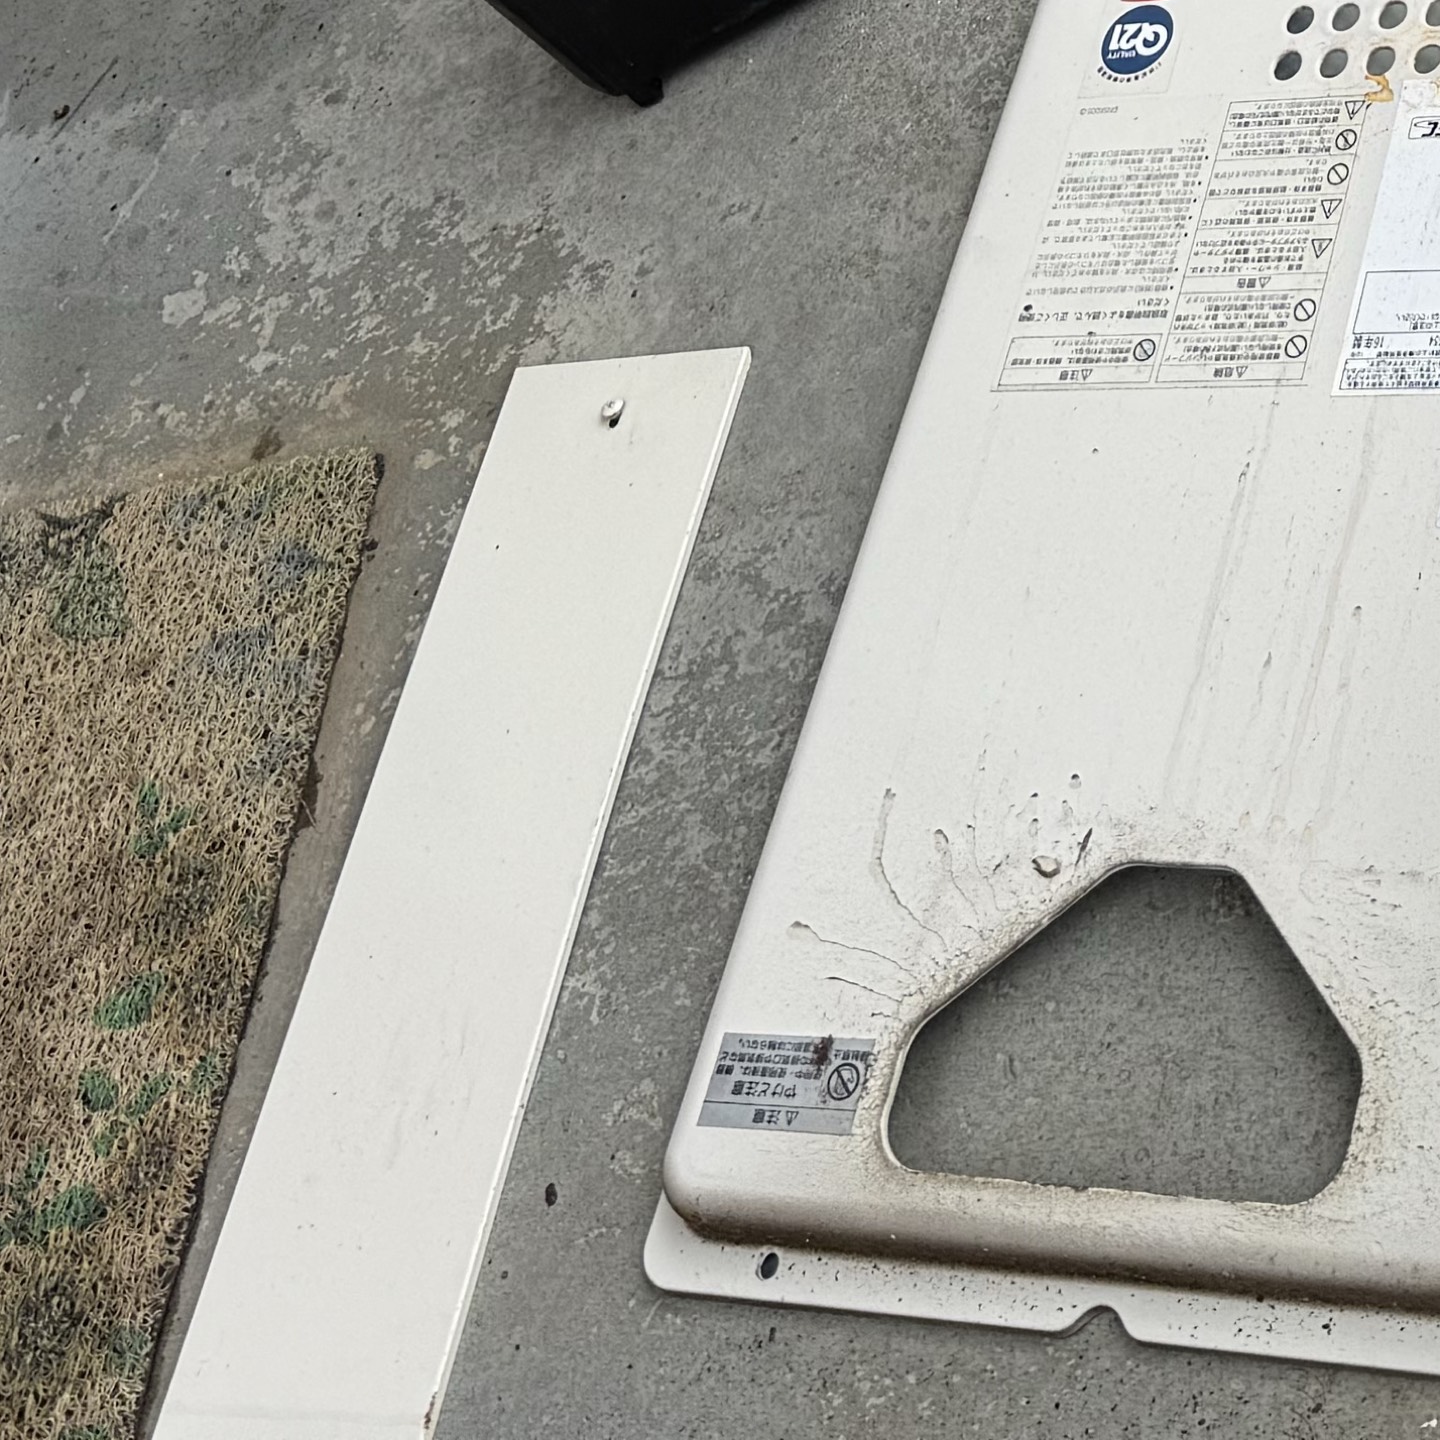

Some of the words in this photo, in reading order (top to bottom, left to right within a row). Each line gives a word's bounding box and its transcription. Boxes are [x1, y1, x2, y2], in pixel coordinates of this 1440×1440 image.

[1106, 20, 1169, 57] Q21
[729, 1080, 798, 1098] やけど注意
[751, 1108, 781, 1124] 注意
